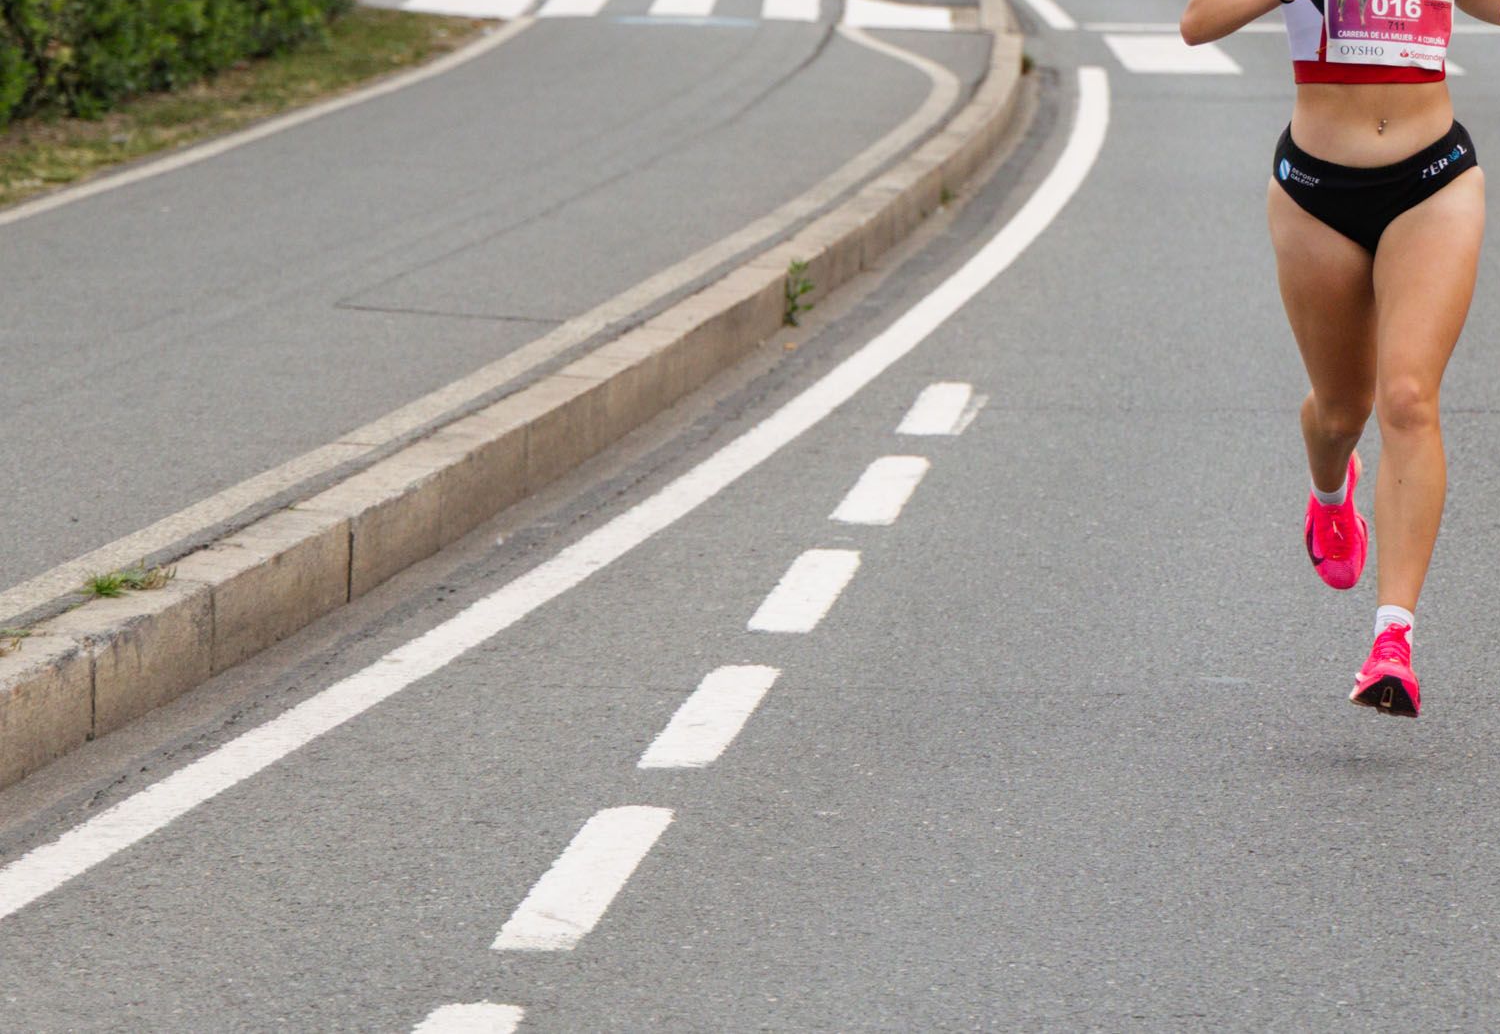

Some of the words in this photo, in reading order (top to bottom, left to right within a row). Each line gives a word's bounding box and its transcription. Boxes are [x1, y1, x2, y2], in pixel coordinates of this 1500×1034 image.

[1387, 21, 1405, 30] 711
[1338, 30, 1369, 39] CARRERA
[1381, 32, 1390, 40] LA
[1391, 33, 1413, 41] MUJER
[1340, 46, 1384, 56] OYSHO
